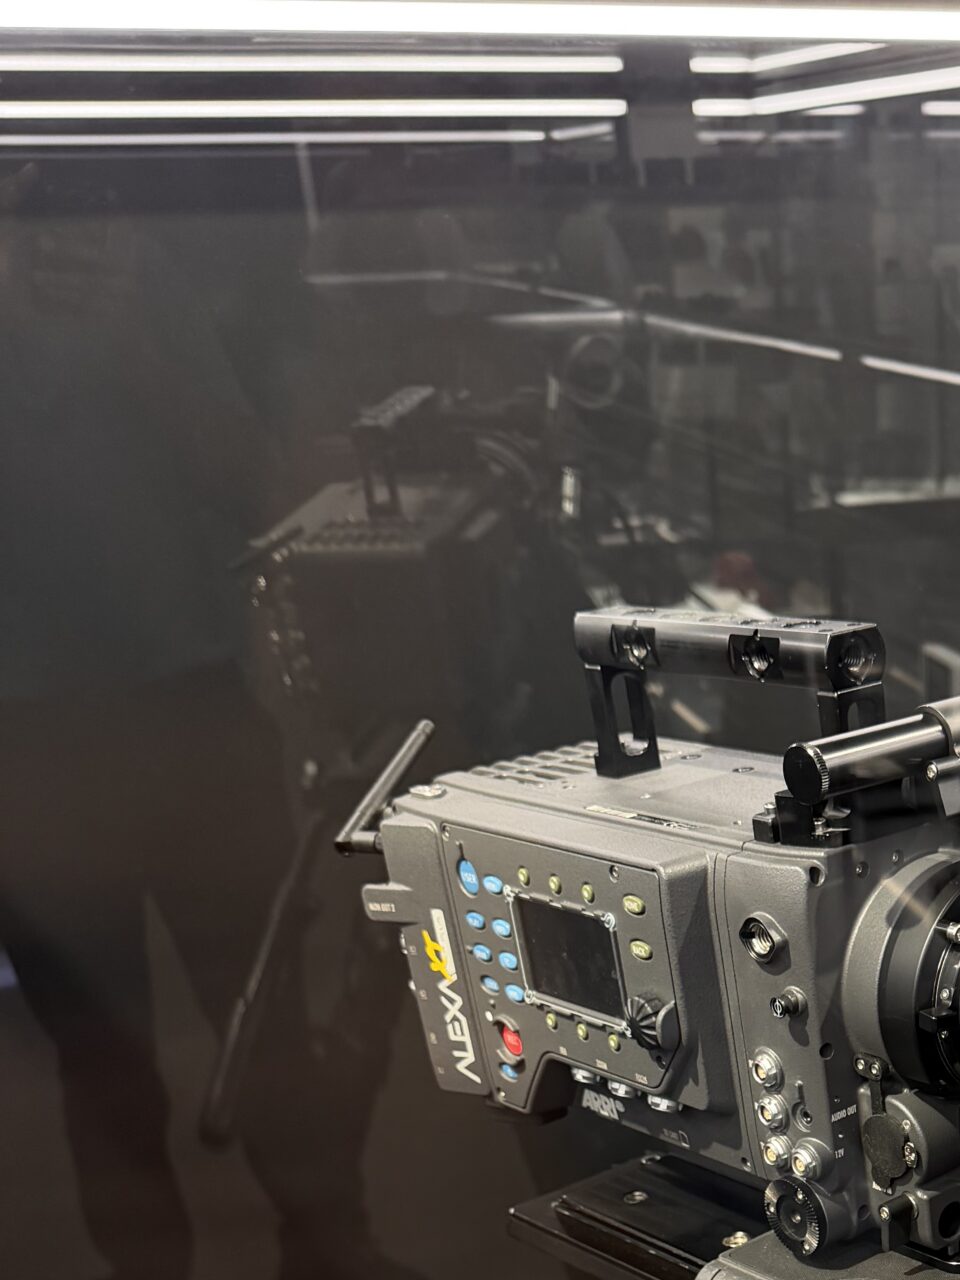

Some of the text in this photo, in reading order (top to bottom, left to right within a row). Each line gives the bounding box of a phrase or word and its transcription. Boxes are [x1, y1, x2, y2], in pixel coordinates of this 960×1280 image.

[437, 972, 483, 1084] ALEXA
[831, 1104, 857, 1123] AUDIO OUT
